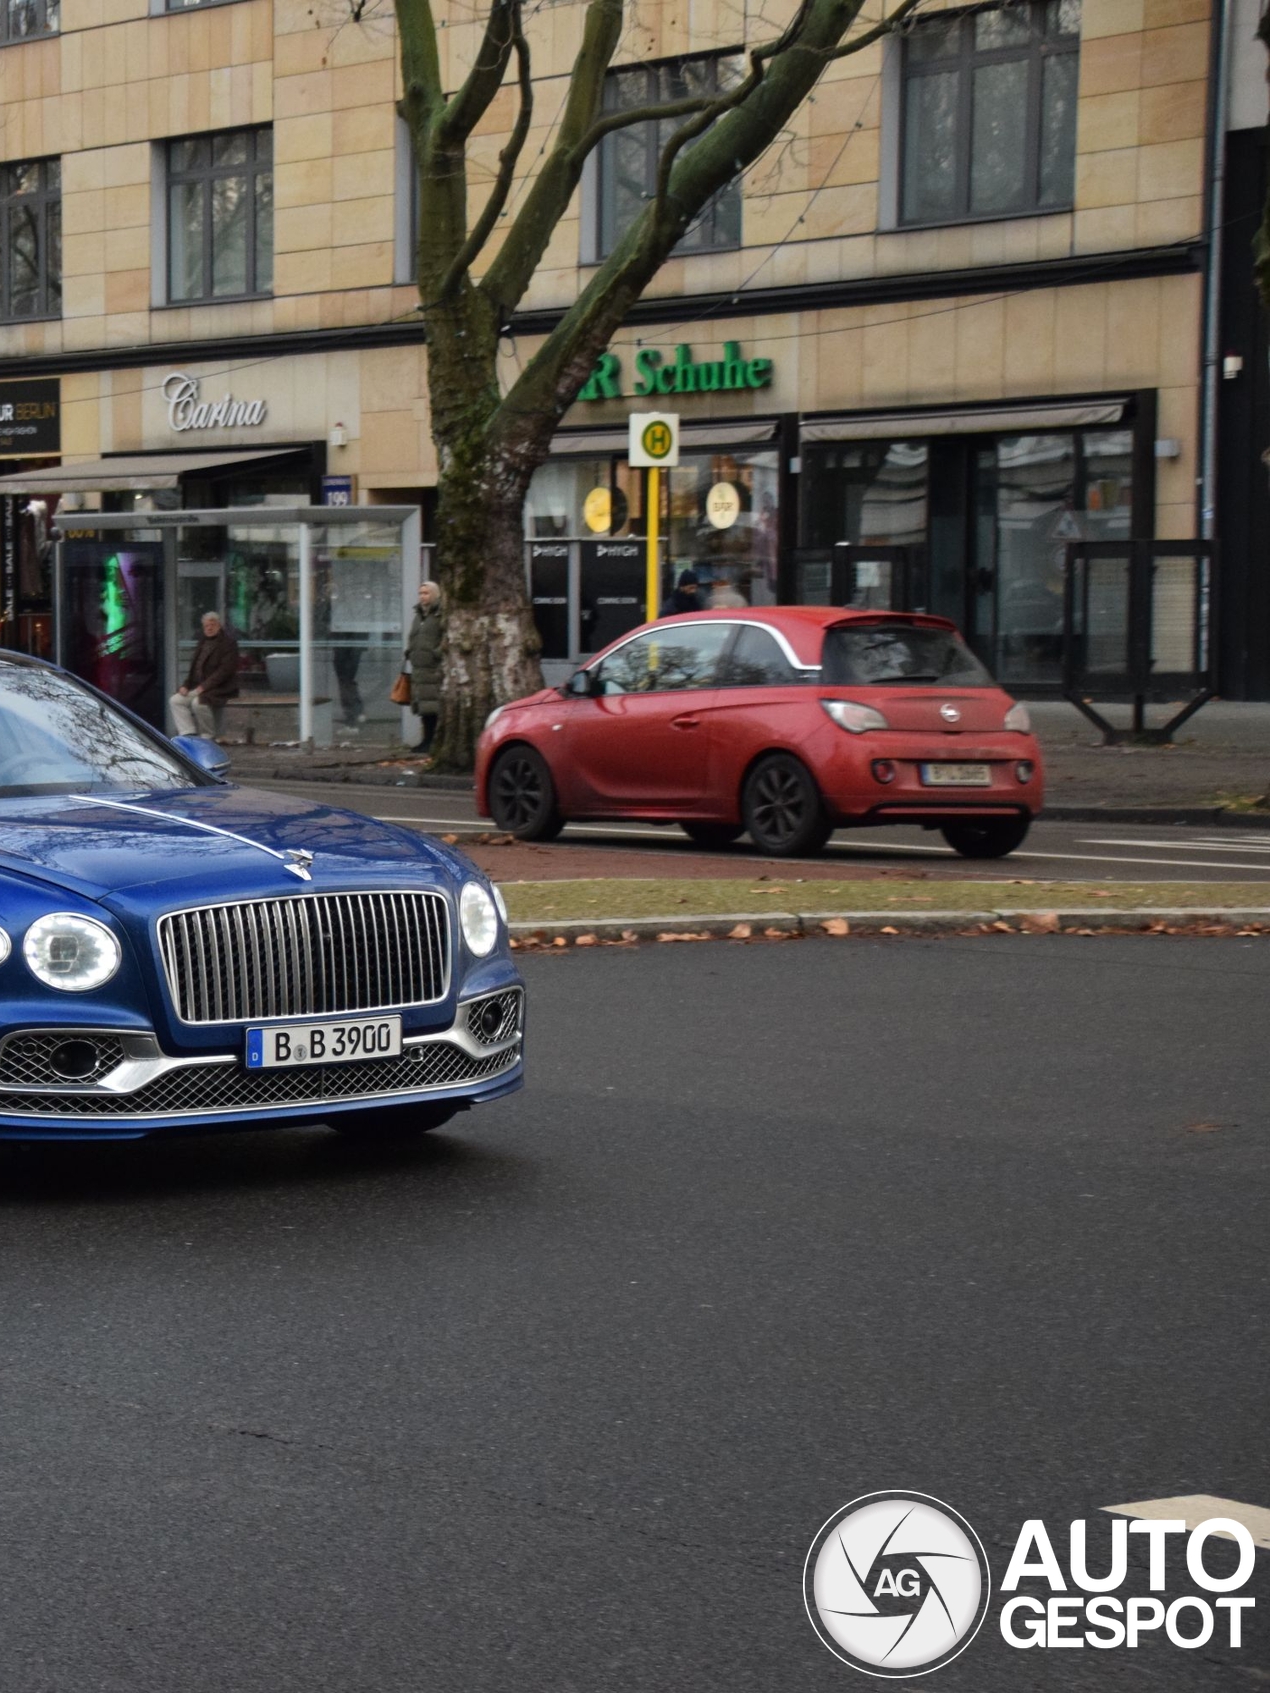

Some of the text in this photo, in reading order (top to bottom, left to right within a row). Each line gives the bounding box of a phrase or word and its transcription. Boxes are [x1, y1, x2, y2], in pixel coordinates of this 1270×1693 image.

[634, 341, 773, 396] Schuhe
[16, 402, 56, 421] BERLIN
[162, 373, 268, 431] Carina
[650, 430, 666, 450] H
[5, 541, 14, 574] SALE
[275, 1032, 292, 1062] B
